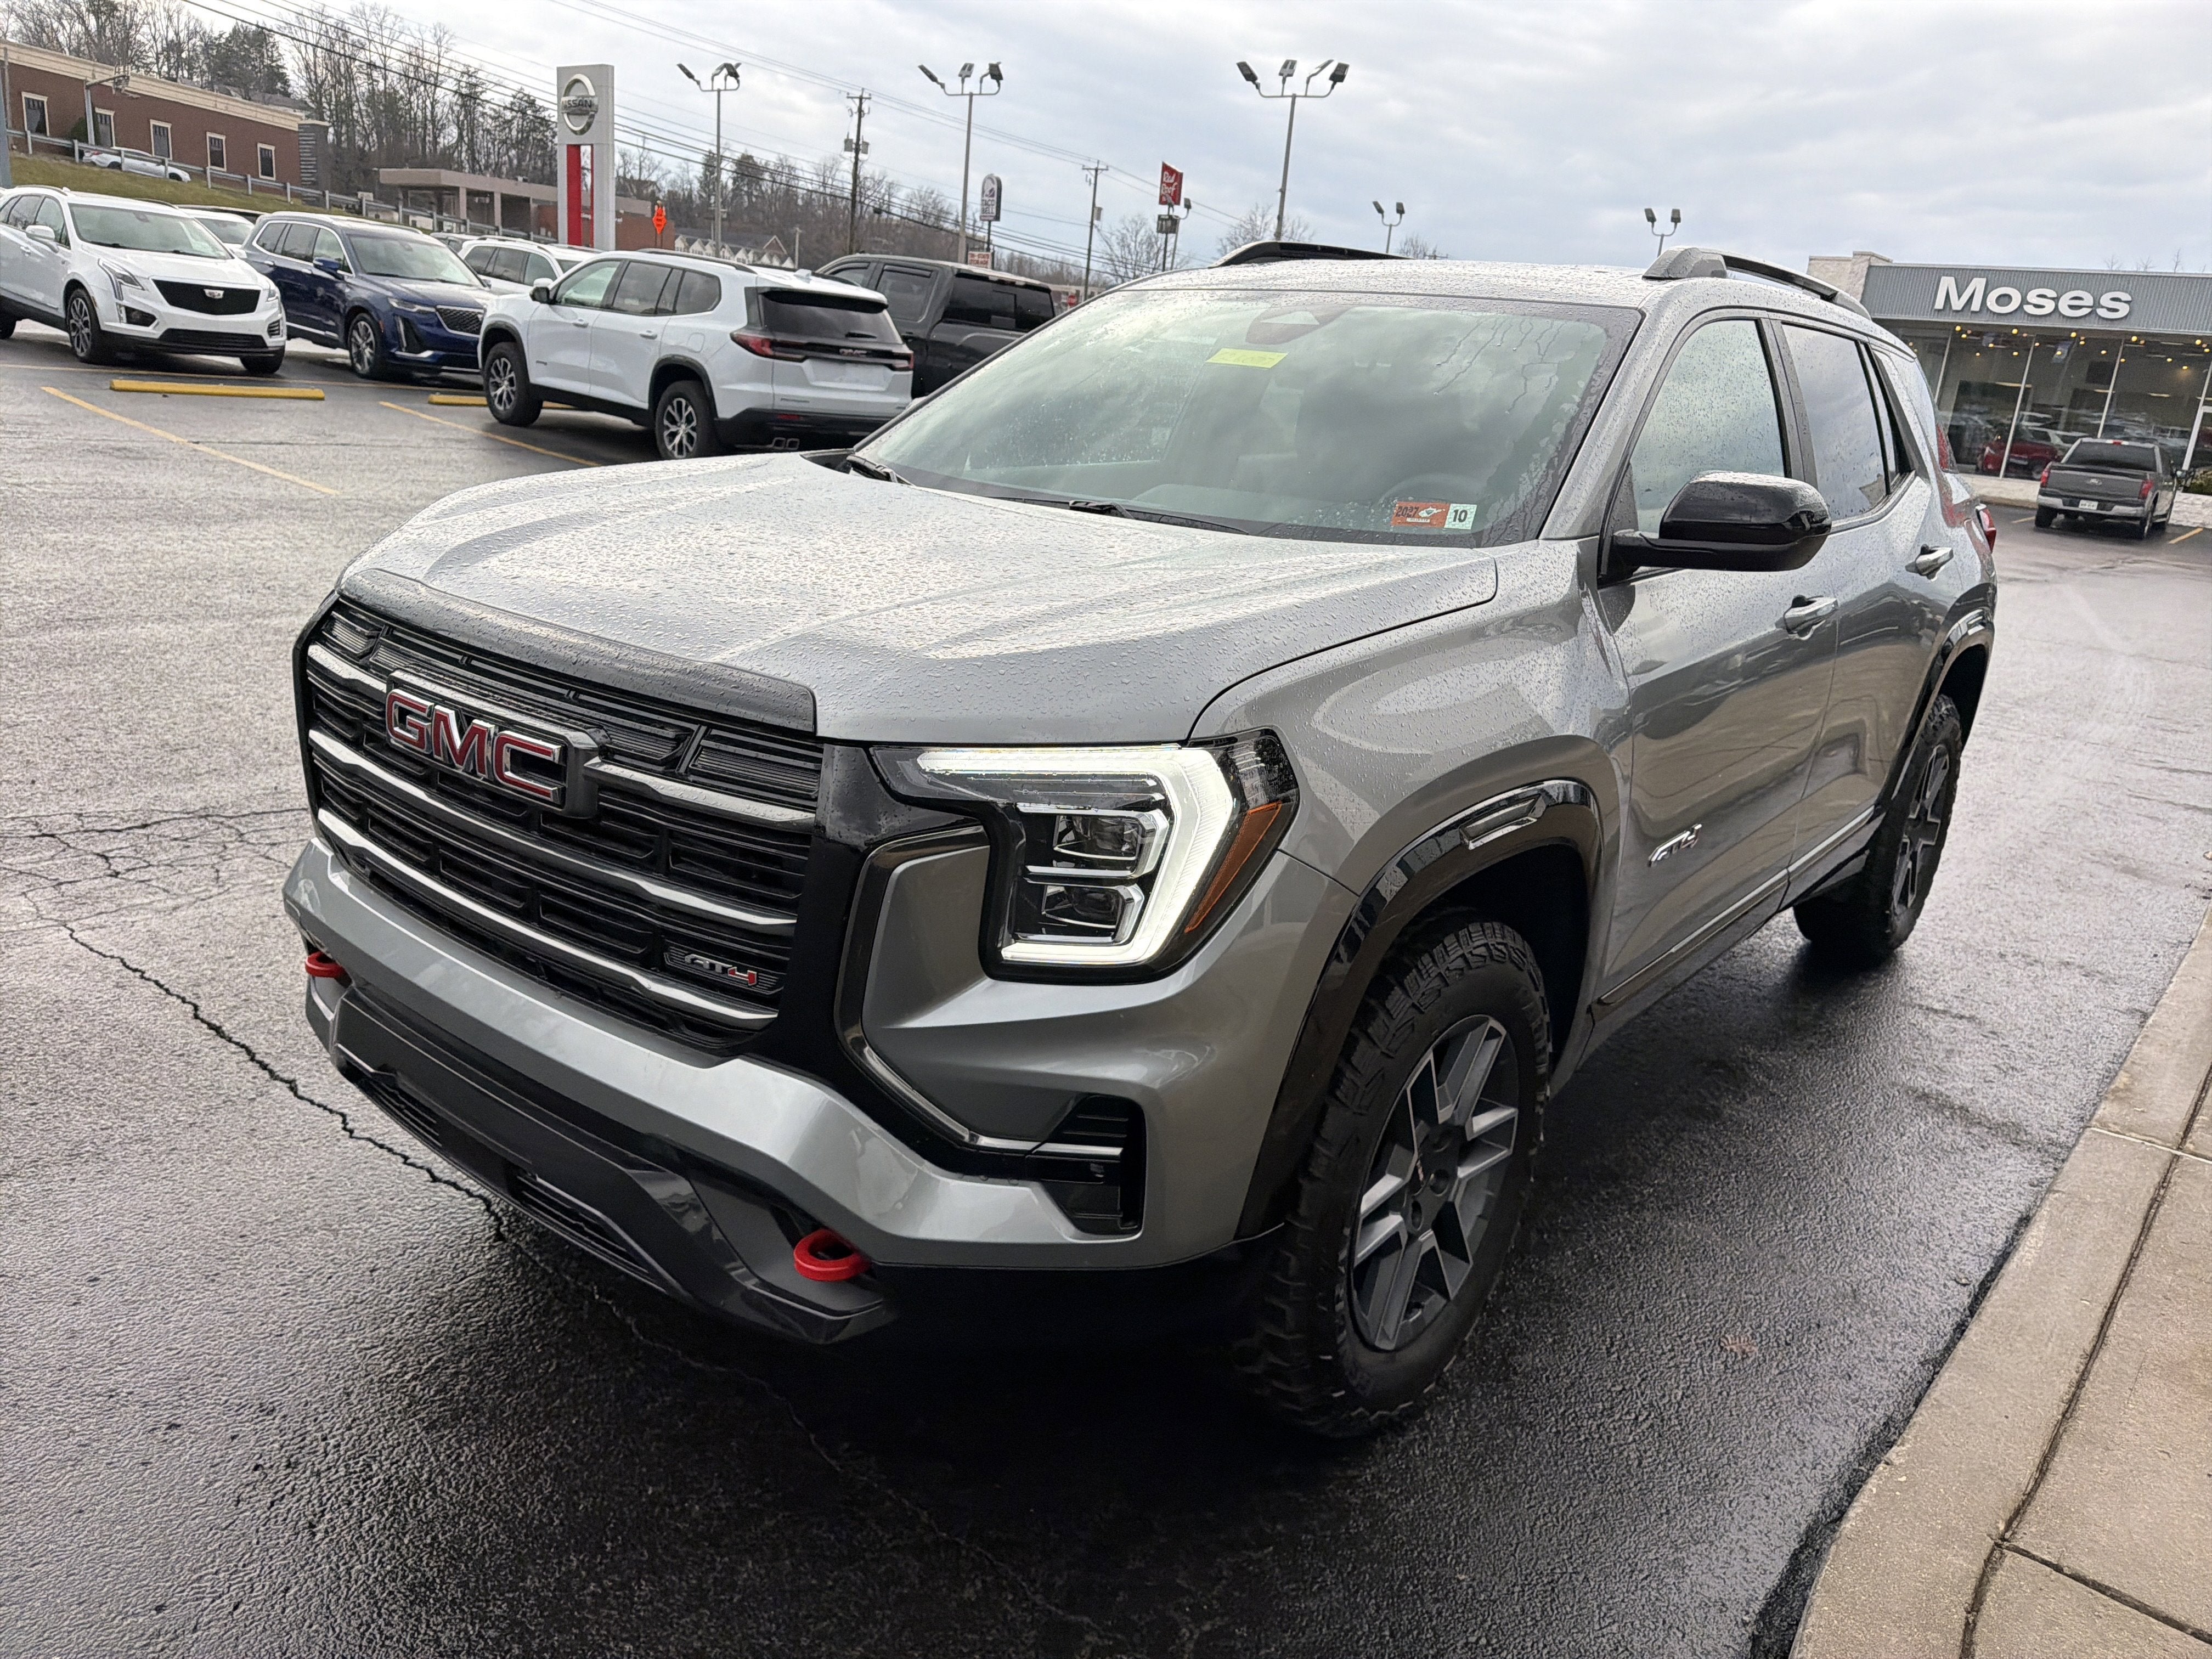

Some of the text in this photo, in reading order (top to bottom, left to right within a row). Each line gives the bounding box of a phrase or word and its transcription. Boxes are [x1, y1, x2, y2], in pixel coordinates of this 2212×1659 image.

[561, 99, 592, 108] ISSAN
[1933, 275, 2132, 320] Moses
[1395, 505, 1469, 523] 2027 10
[385, 688, 563, 805] GMC
[1647, 823, 1702, 867] AT4
[684, 953, 758, 987] AT4
